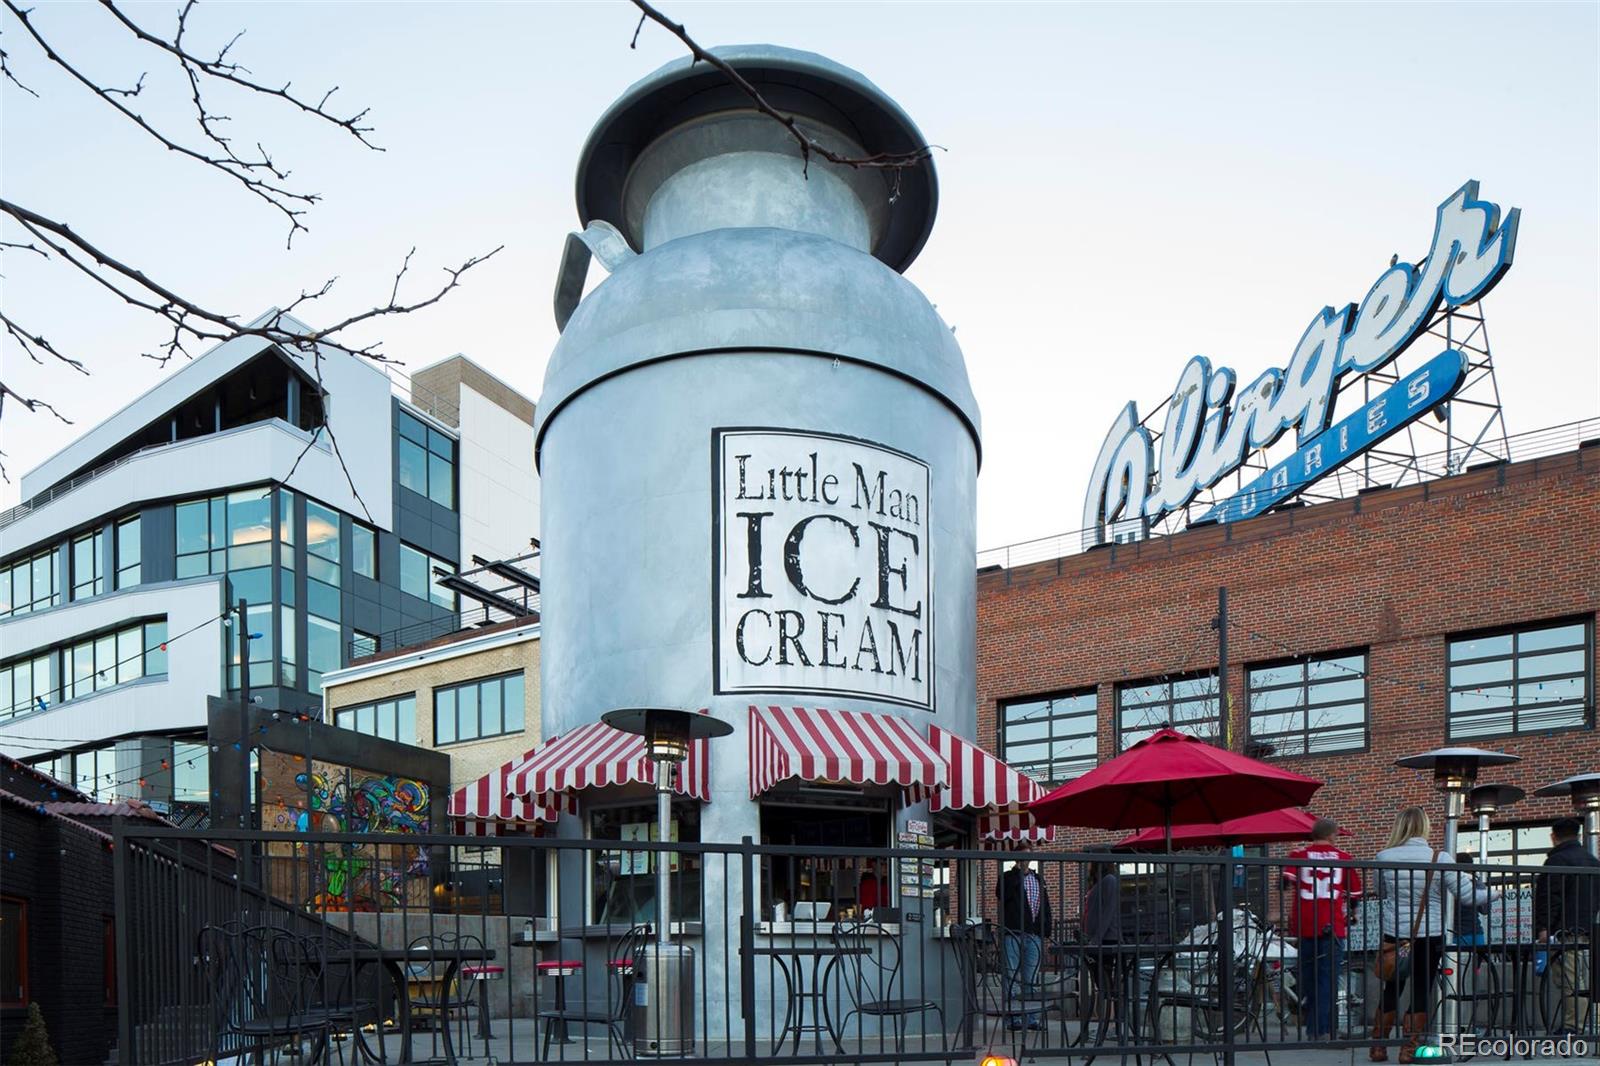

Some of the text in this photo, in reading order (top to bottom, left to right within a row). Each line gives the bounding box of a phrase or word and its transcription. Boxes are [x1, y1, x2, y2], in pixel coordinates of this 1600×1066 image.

[1082, 179, 1521, 550] Olinger
[735, 452, 920, 526] Little Man
[736, 511, 922, 620] ICE
[735, 608, 923, 683] CREAM
[1300, 867, 1343, 900] 52
